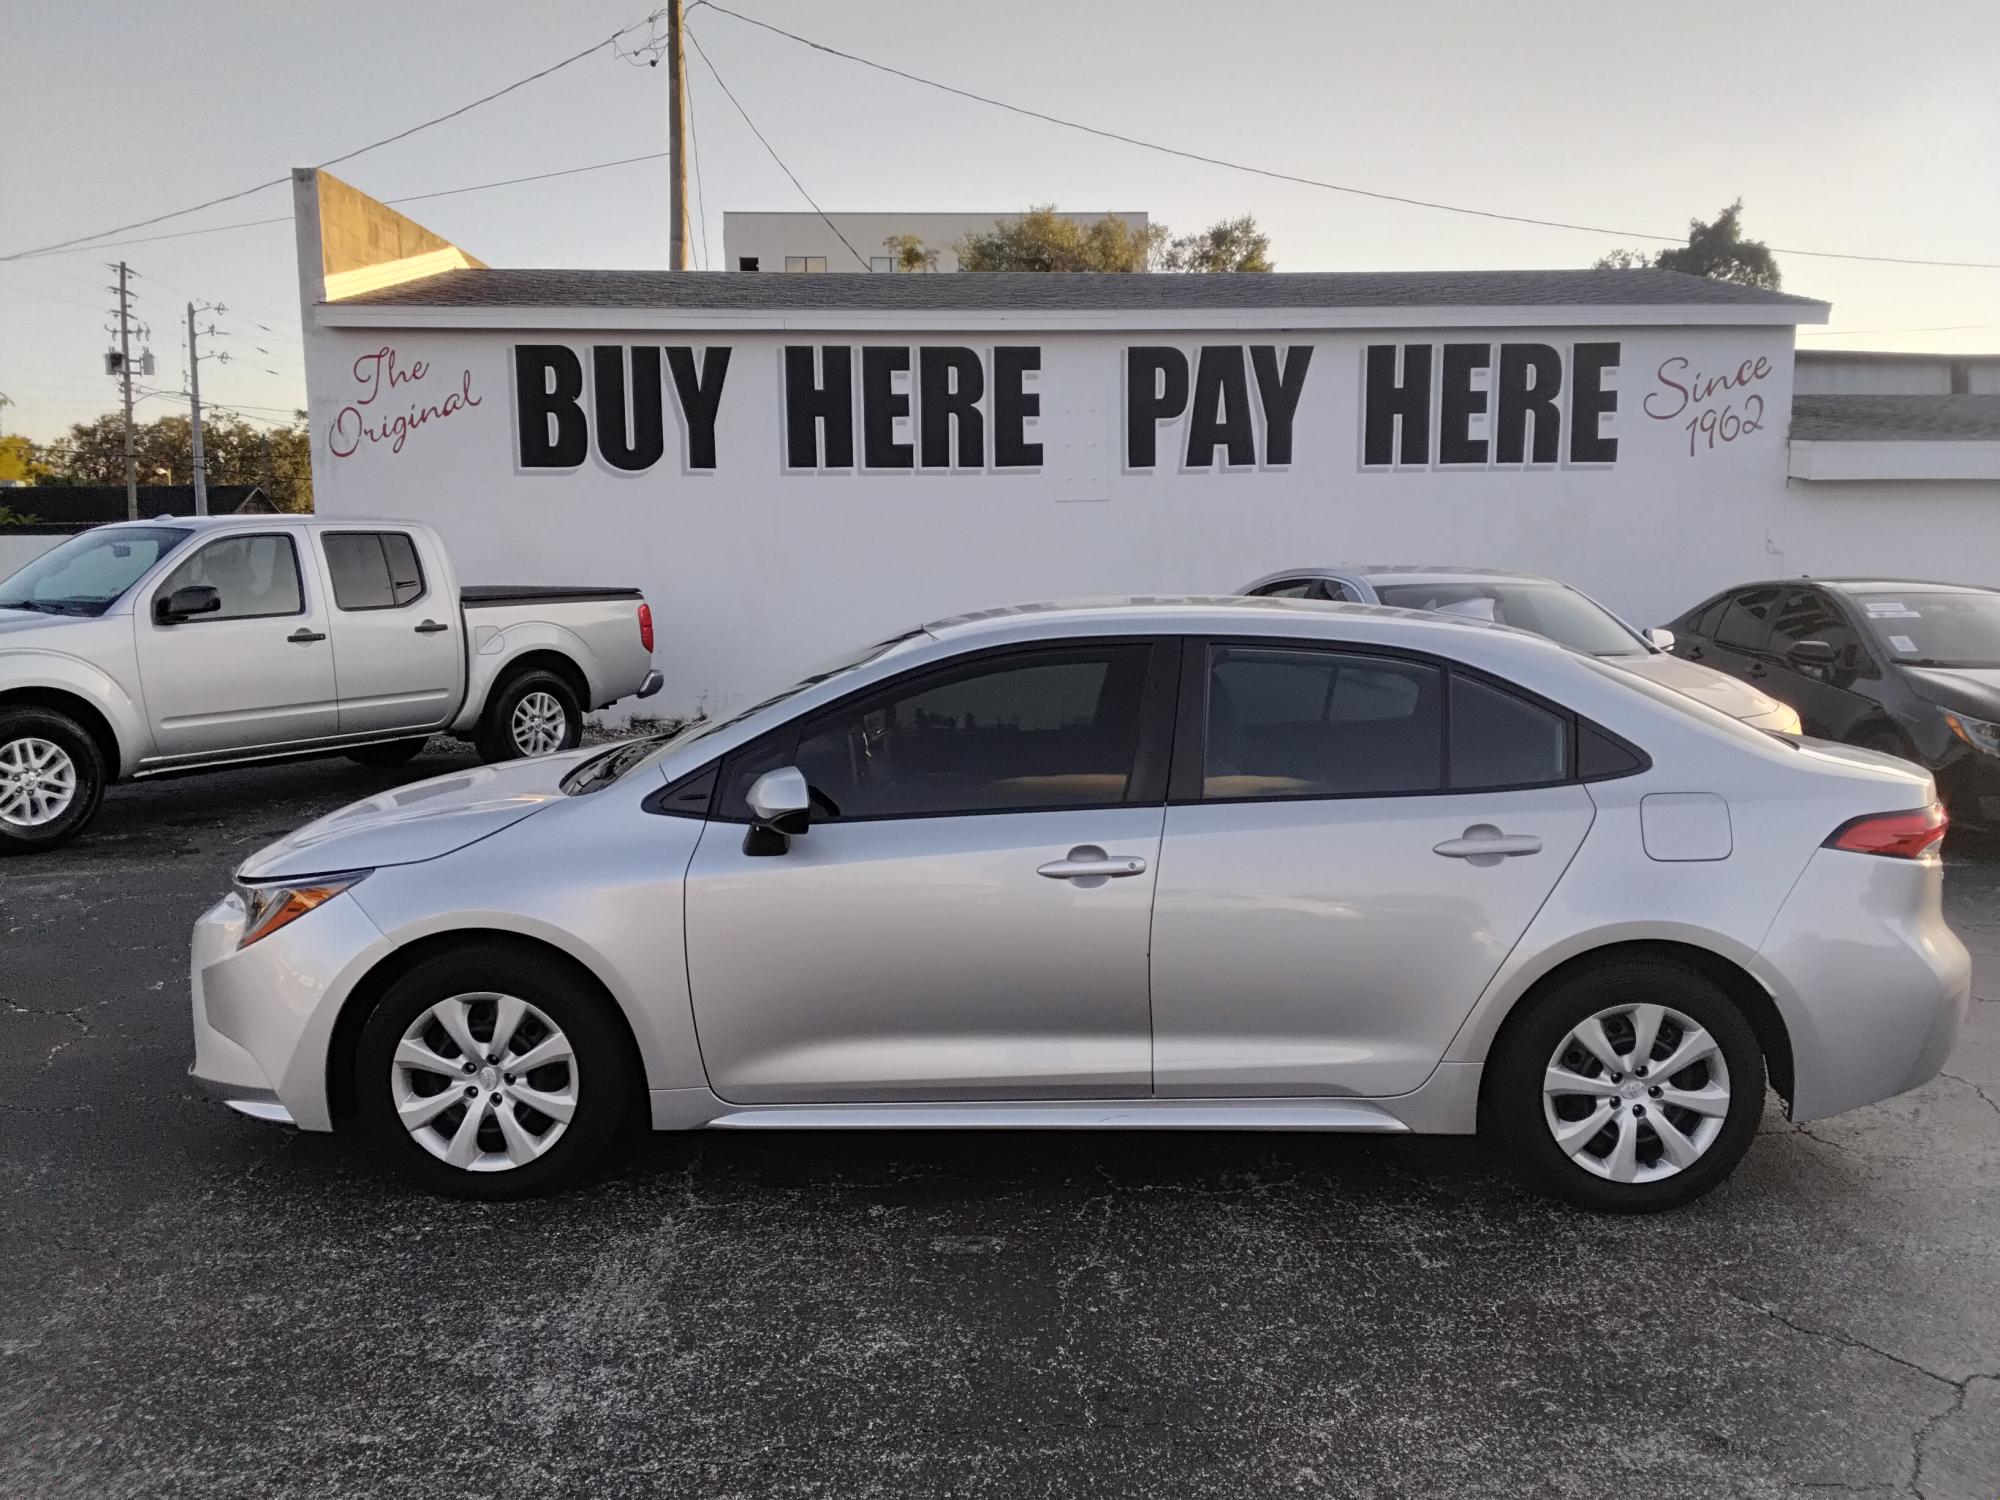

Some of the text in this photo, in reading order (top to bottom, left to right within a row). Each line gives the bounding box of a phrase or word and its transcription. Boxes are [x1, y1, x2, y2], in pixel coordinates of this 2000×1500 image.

[353, 346, 430, 405] The
[514, 342, 1621, 471] BUY HERE PAY HERE
[1643, 356, 1772, 420] Since
[328, 369, 482, 458] Original
[1685, 394, 1764, 457] 1962
